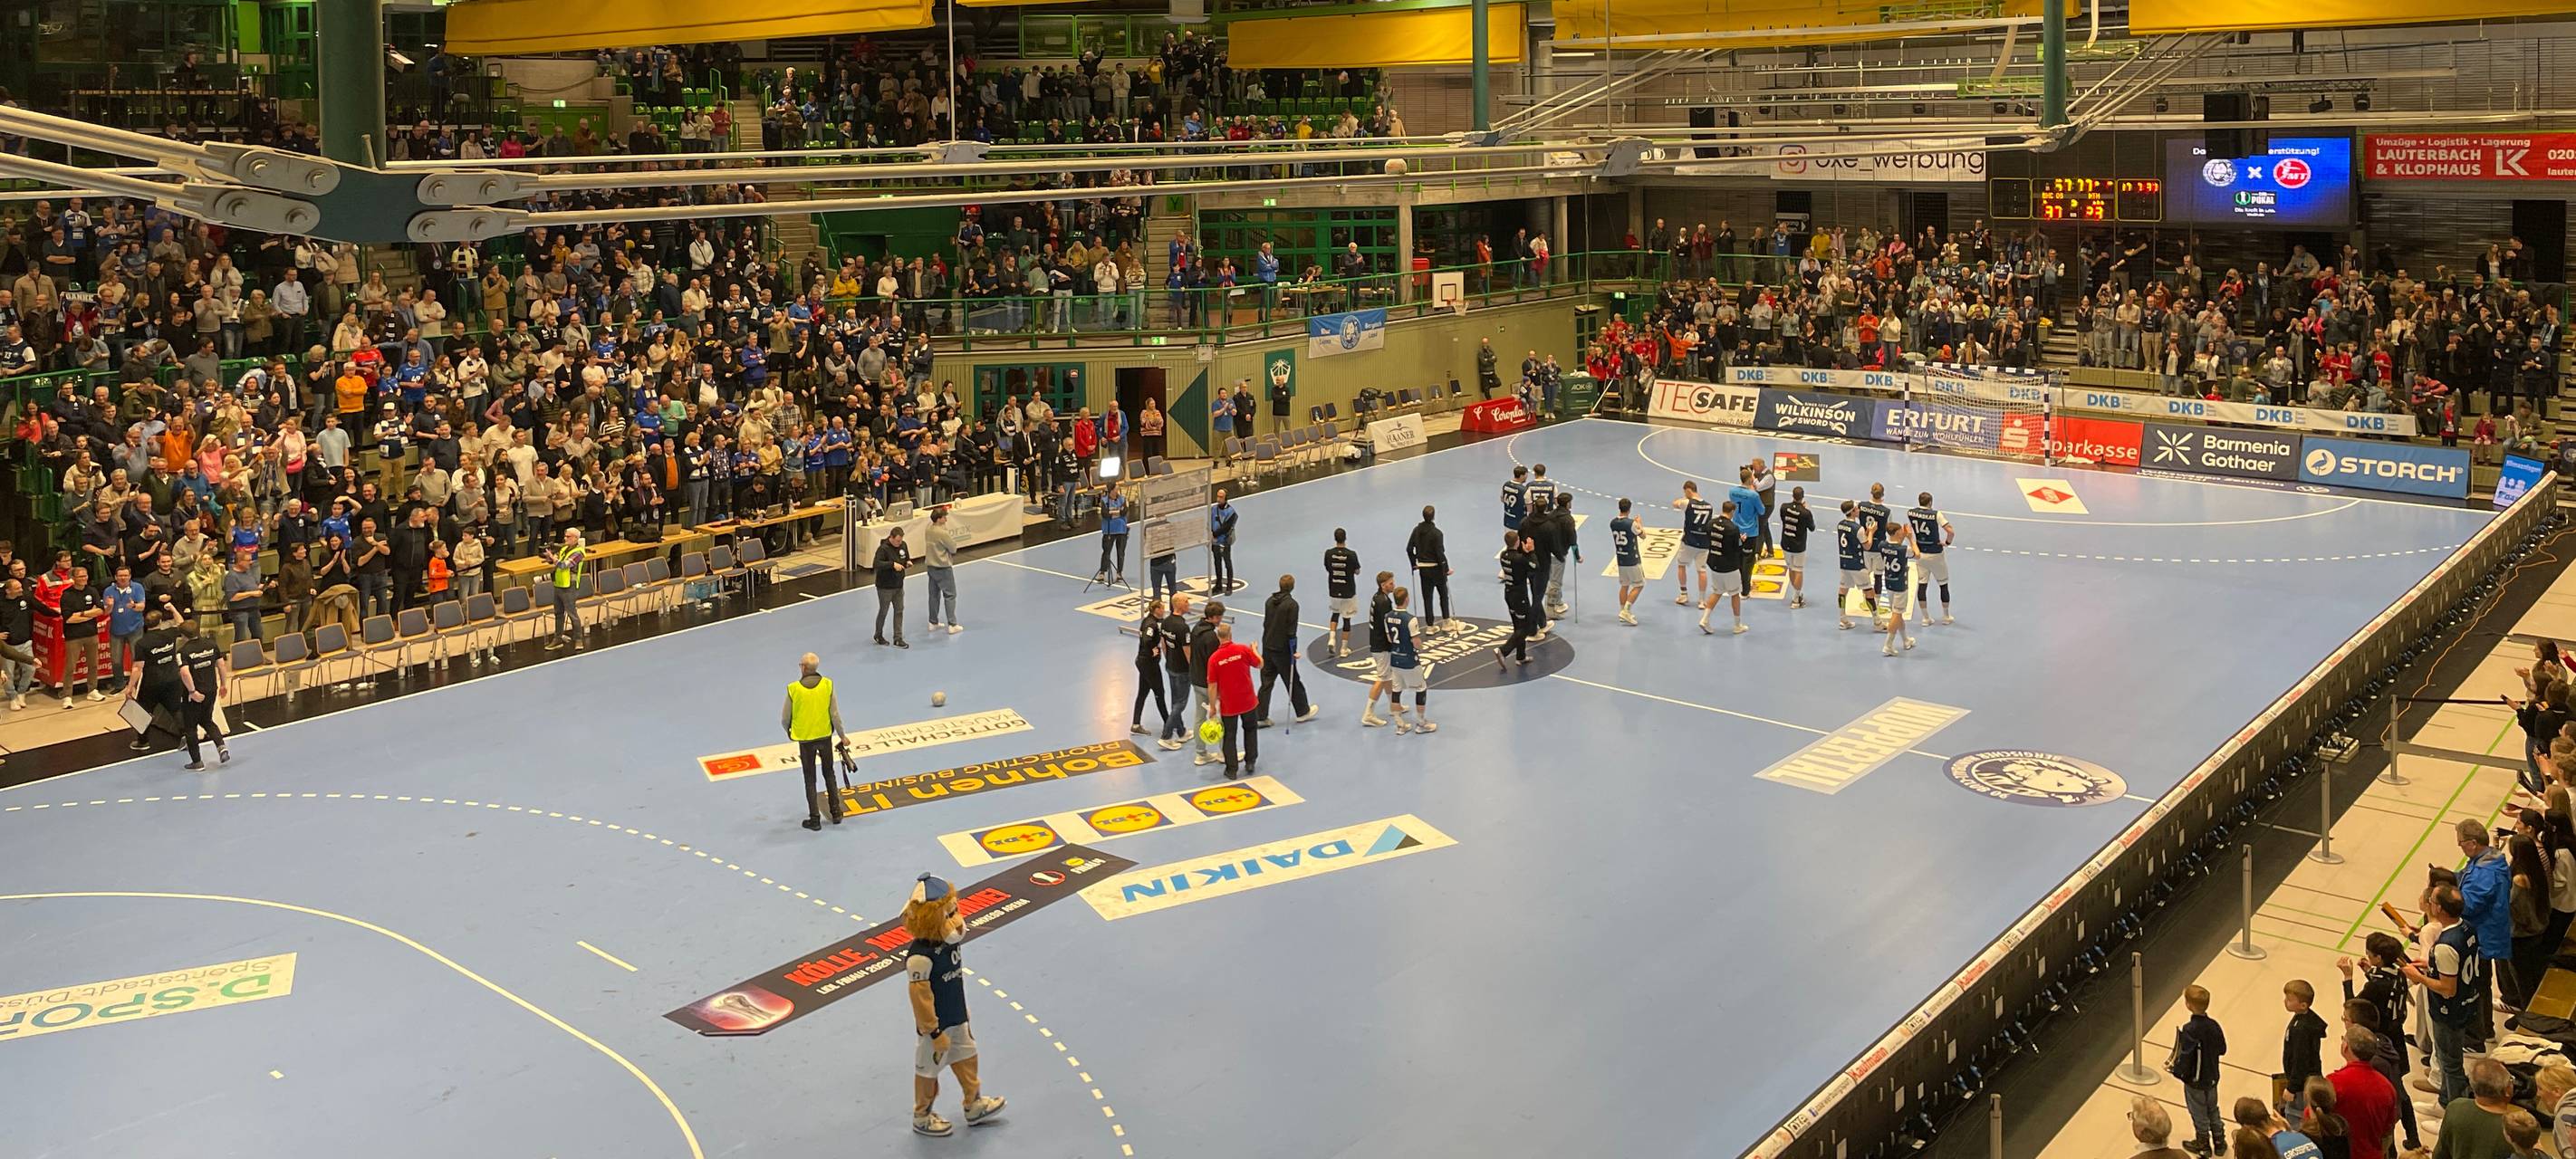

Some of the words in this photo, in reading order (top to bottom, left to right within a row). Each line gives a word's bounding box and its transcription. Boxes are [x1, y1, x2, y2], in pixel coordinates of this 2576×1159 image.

[2376, 138, 2417, 148] Umzüge
[2427, 138, 2470, 148] Logistik
[2480, 138, 2532, 148] Lagerung
[2376, 148, 2482, 161] LAUTERBACH
[2547, 148, 2576, 160] 020
[2375, 163, 2389, 175] &
[2394, 163, 2482, 176] KLOPHAUS
[1736, 369, 1764, 381] DKB
[1801, 371, 1828, 384] DKB
[1865, 373, 1893, 387] DKB
[2086, 393, 2121, 408] DKB
[2168, 400, 2205, 416] DKB
[1491, 404, 1526, 424] Coropla
[1775, 403, 1856, 422] WILKINSON
[2255, 407, 2293, 423] DKB
[1797, 417, 1830, 427] SWORD
[2346, 415, 2386, 431] DKB
[1932, 431, 1985, 444] WOHLFÜHLEN
[2203, 434, 2291, 456] Barmenia
[2040, 438, 2139, 460] Sparkasse
[2201, 451, 2276, 473] Gothaer
[2339, 456, 2457, 484] STORCH
[1693, 509, 1711, 525] 77
[1912, 519, 1931, 536] 14
[1612, 531, 1629, 546] 25
[1840, 532, 1849, 548] 6
[1884, 556, 1901, 572] 46
[1390, 627, 1400, 644] 2
[870, 708, 1019, 741] HAUSTECHNIK
[884, 718, 1027, 747] GOTTSCHALL
[1767, 700, 1962, 786] WUPPERTAL
[964, 741, 1121, 773] PROTECTING
[826, 769, 959, 796] BUSINES
[908, 750, 1144, 800] Bohnen
[842, 792, 894, 818] IT
[1120, 838, 1356, 904] DAIKIN
[783, 946, 879, 987] KÖLLE,
[79, 960, 273, 996] Sportstadt
[1848, 1046, 1889, 1079] Kaufmann
